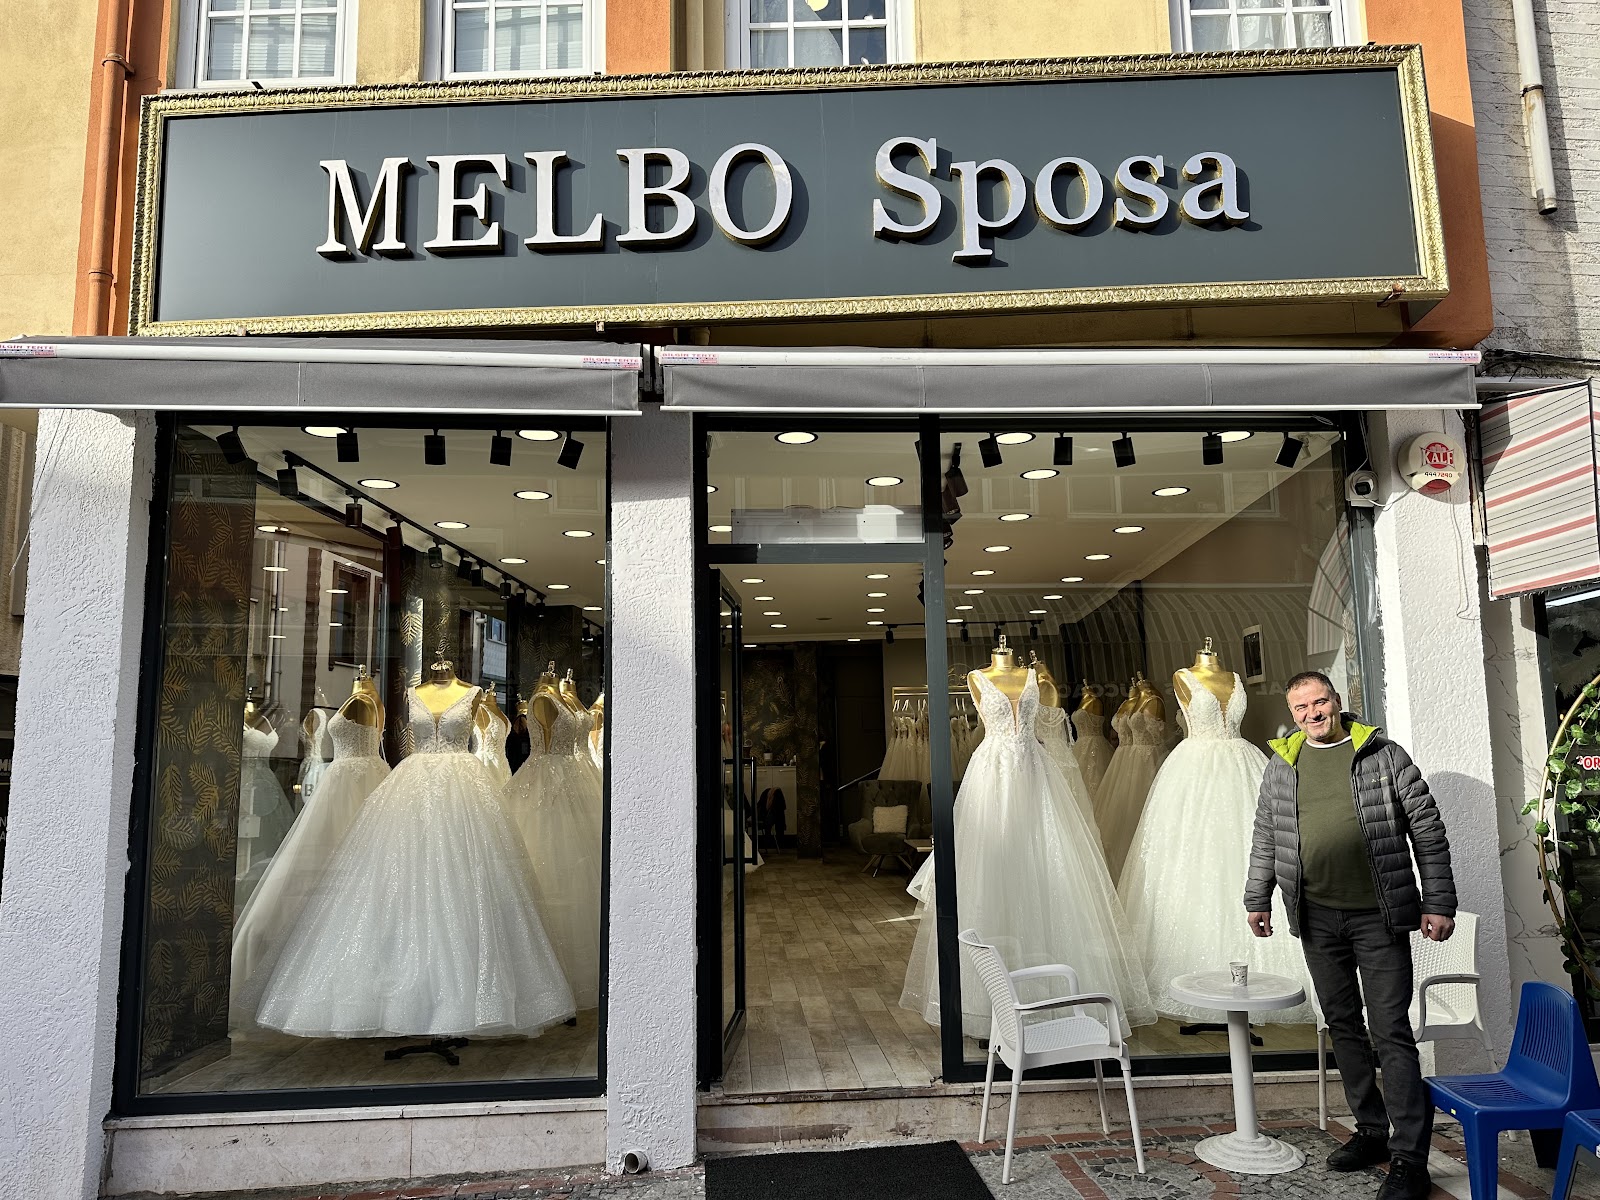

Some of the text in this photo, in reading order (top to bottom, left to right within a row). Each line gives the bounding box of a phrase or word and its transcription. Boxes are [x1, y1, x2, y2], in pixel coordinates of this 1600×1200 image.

[316, 136, 1250, 260] MELBO Sposa
[1421, 449, 1456, 466] KALE
